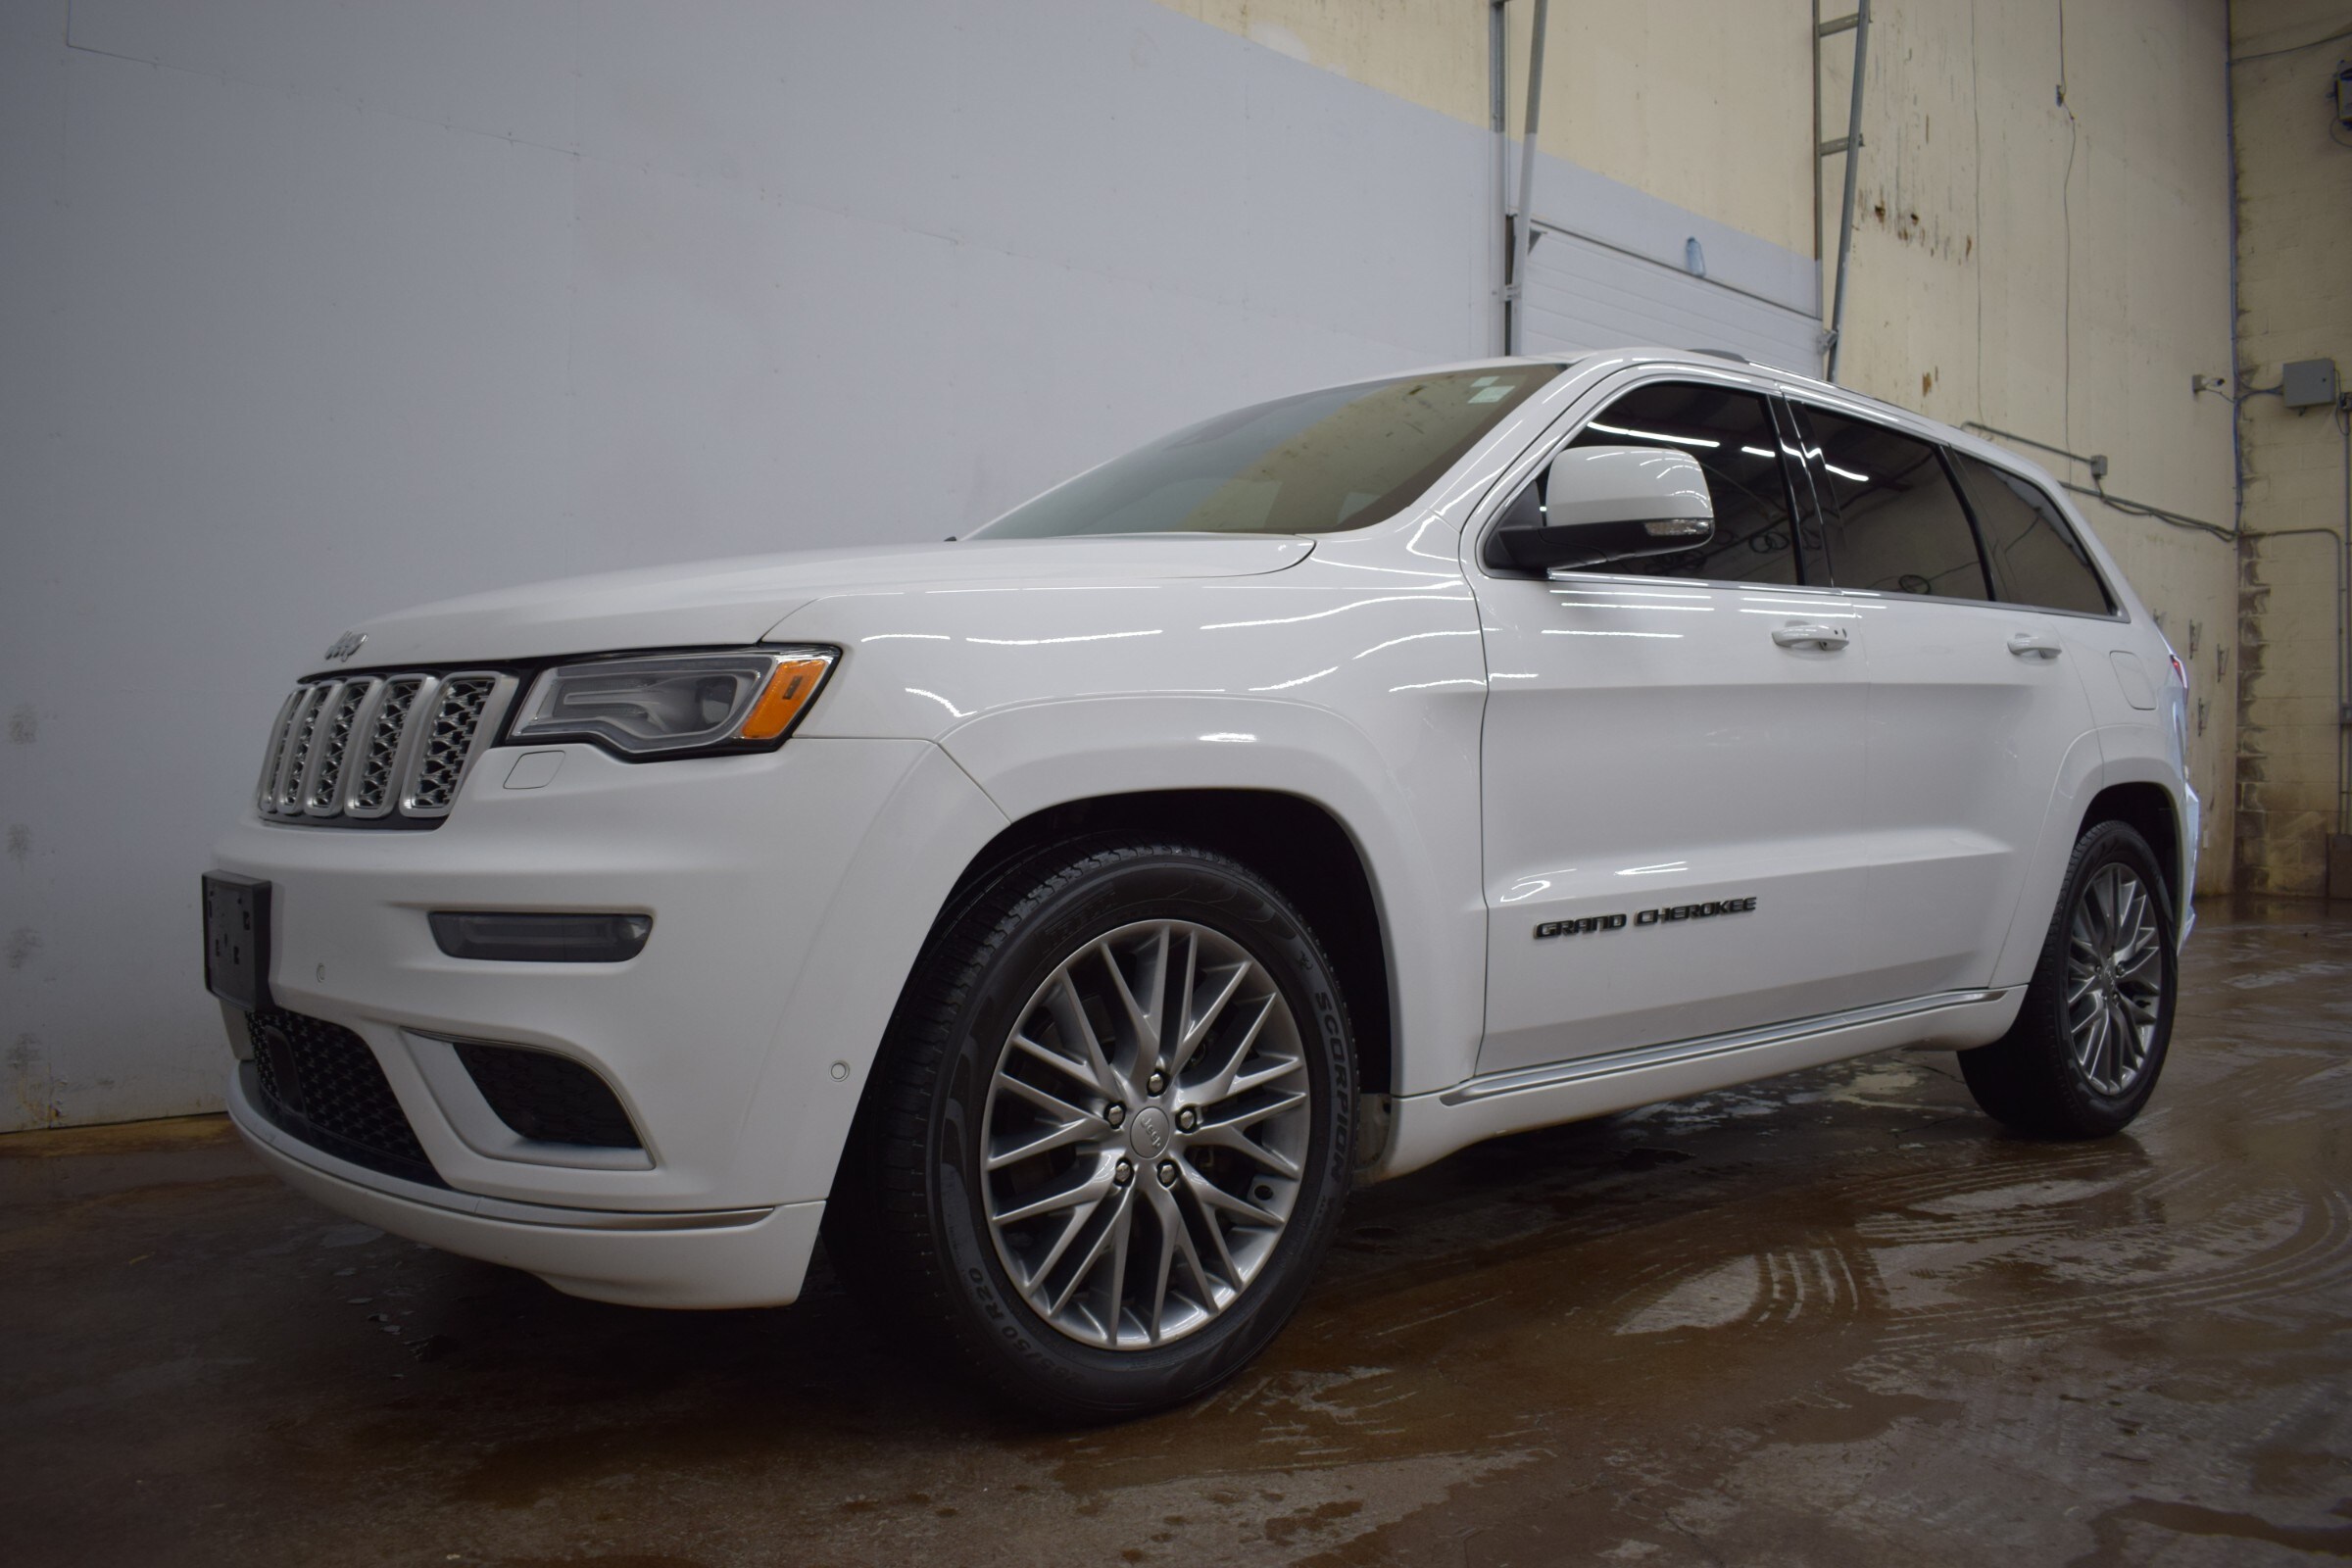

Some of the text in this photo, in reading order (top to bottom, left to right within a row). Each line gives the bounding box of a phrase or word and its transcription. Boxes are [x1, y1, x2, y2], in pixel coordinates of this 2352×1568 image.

[1533, 897, 1757, 940] GRAND CHEROKEE
[1316, 991, 1349, 1181] SCORPION
[1140, 1117, 1161, 1148] Jeep
[970, 1268, 1004, 1319] R20
